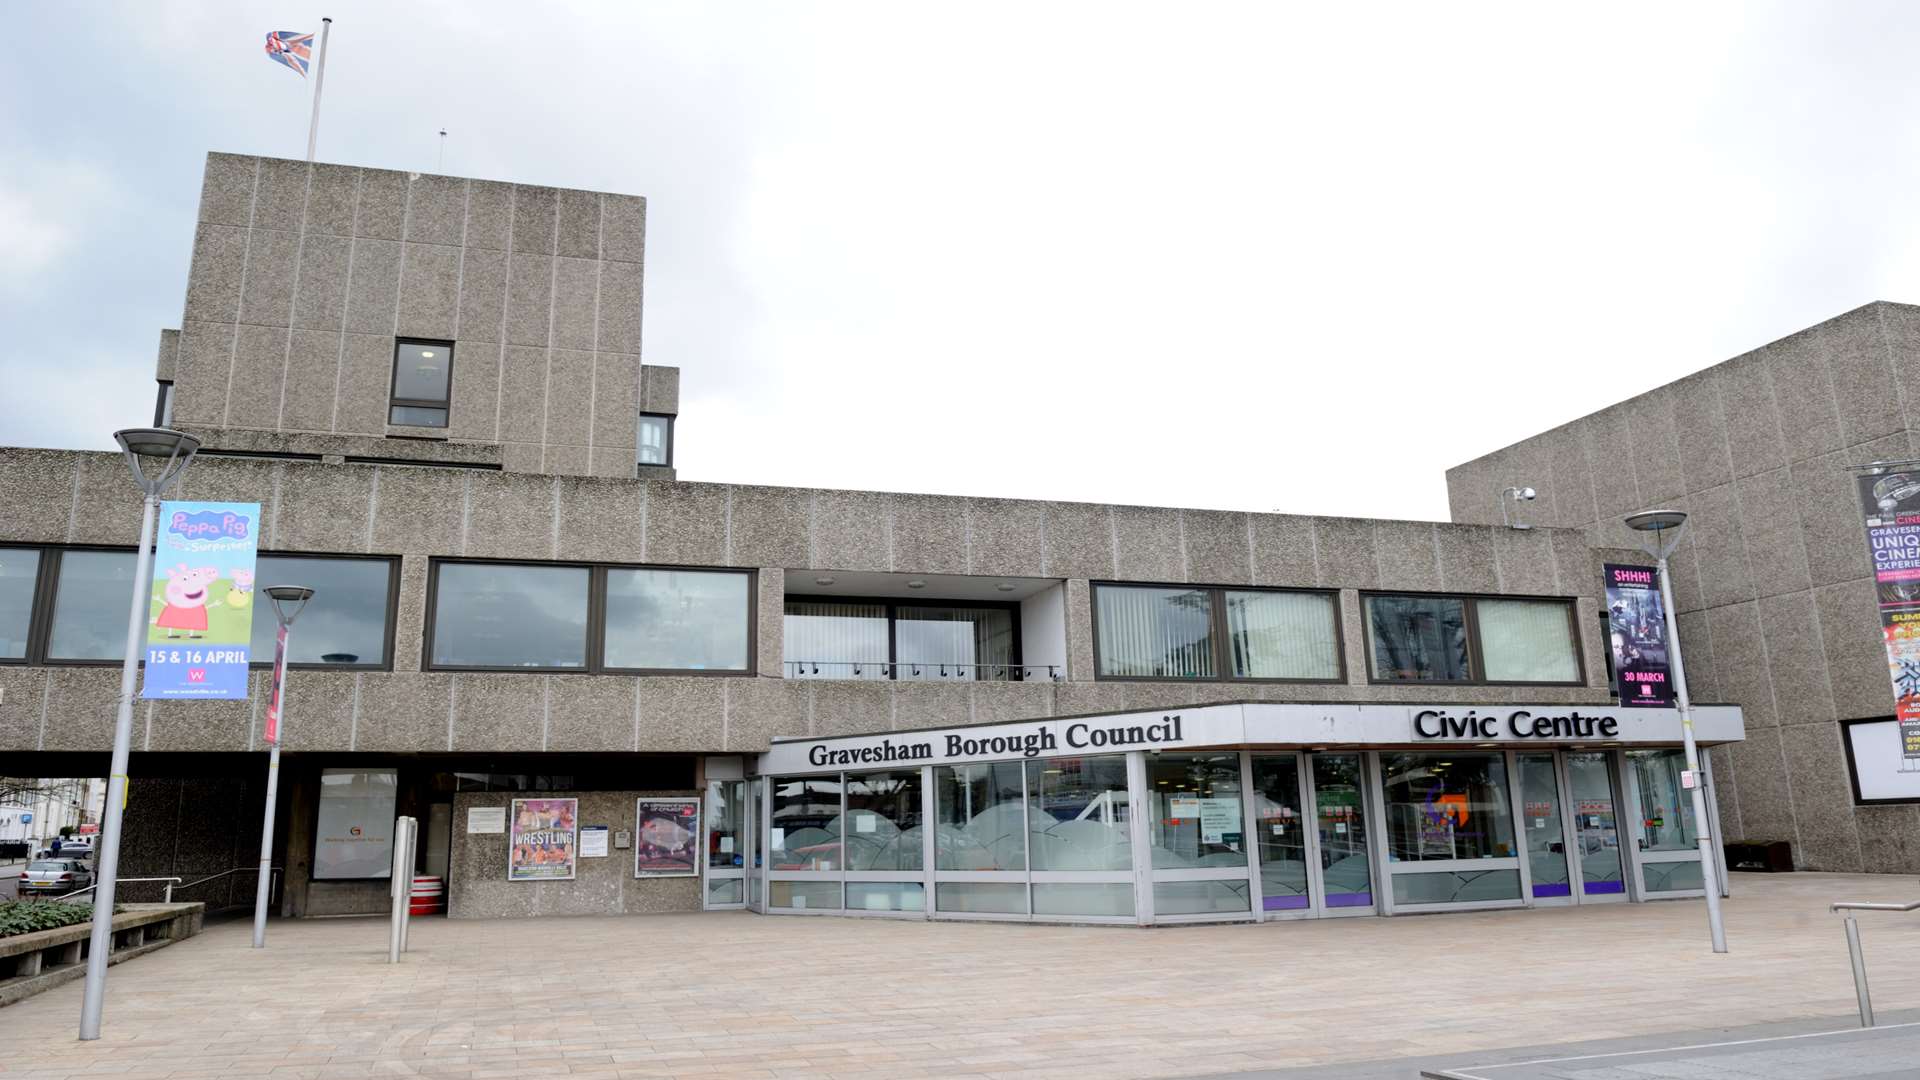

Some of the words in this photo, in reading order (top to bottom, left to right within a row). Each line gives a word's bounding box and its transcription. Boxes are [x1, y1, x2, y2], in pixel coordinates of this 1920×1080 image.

[173, 513, 220, 537] Peppa
[223, 514, 247, 537] Pig
[1614, 569, 1651, 583] SHHH!
[150, 650, 166, 664] 15
[169, 650, 181, 664] &
[185, 650, 202, 664] 16
[205, 650, 247, 664] APRIL
[1624, 671, 1635, 682] 30
[1636, 671, 1665, 682] MARCH
[1414, 710, 1498, 738] Civic
[1508, 711, 1618, 738] Centre
[809, 740, 933, 766] Gravesham
[944, 726, 1057, 757] Borough
[1066, 715, 1183, 748] Council
[515, 831, 573, 845] WRESTLING
